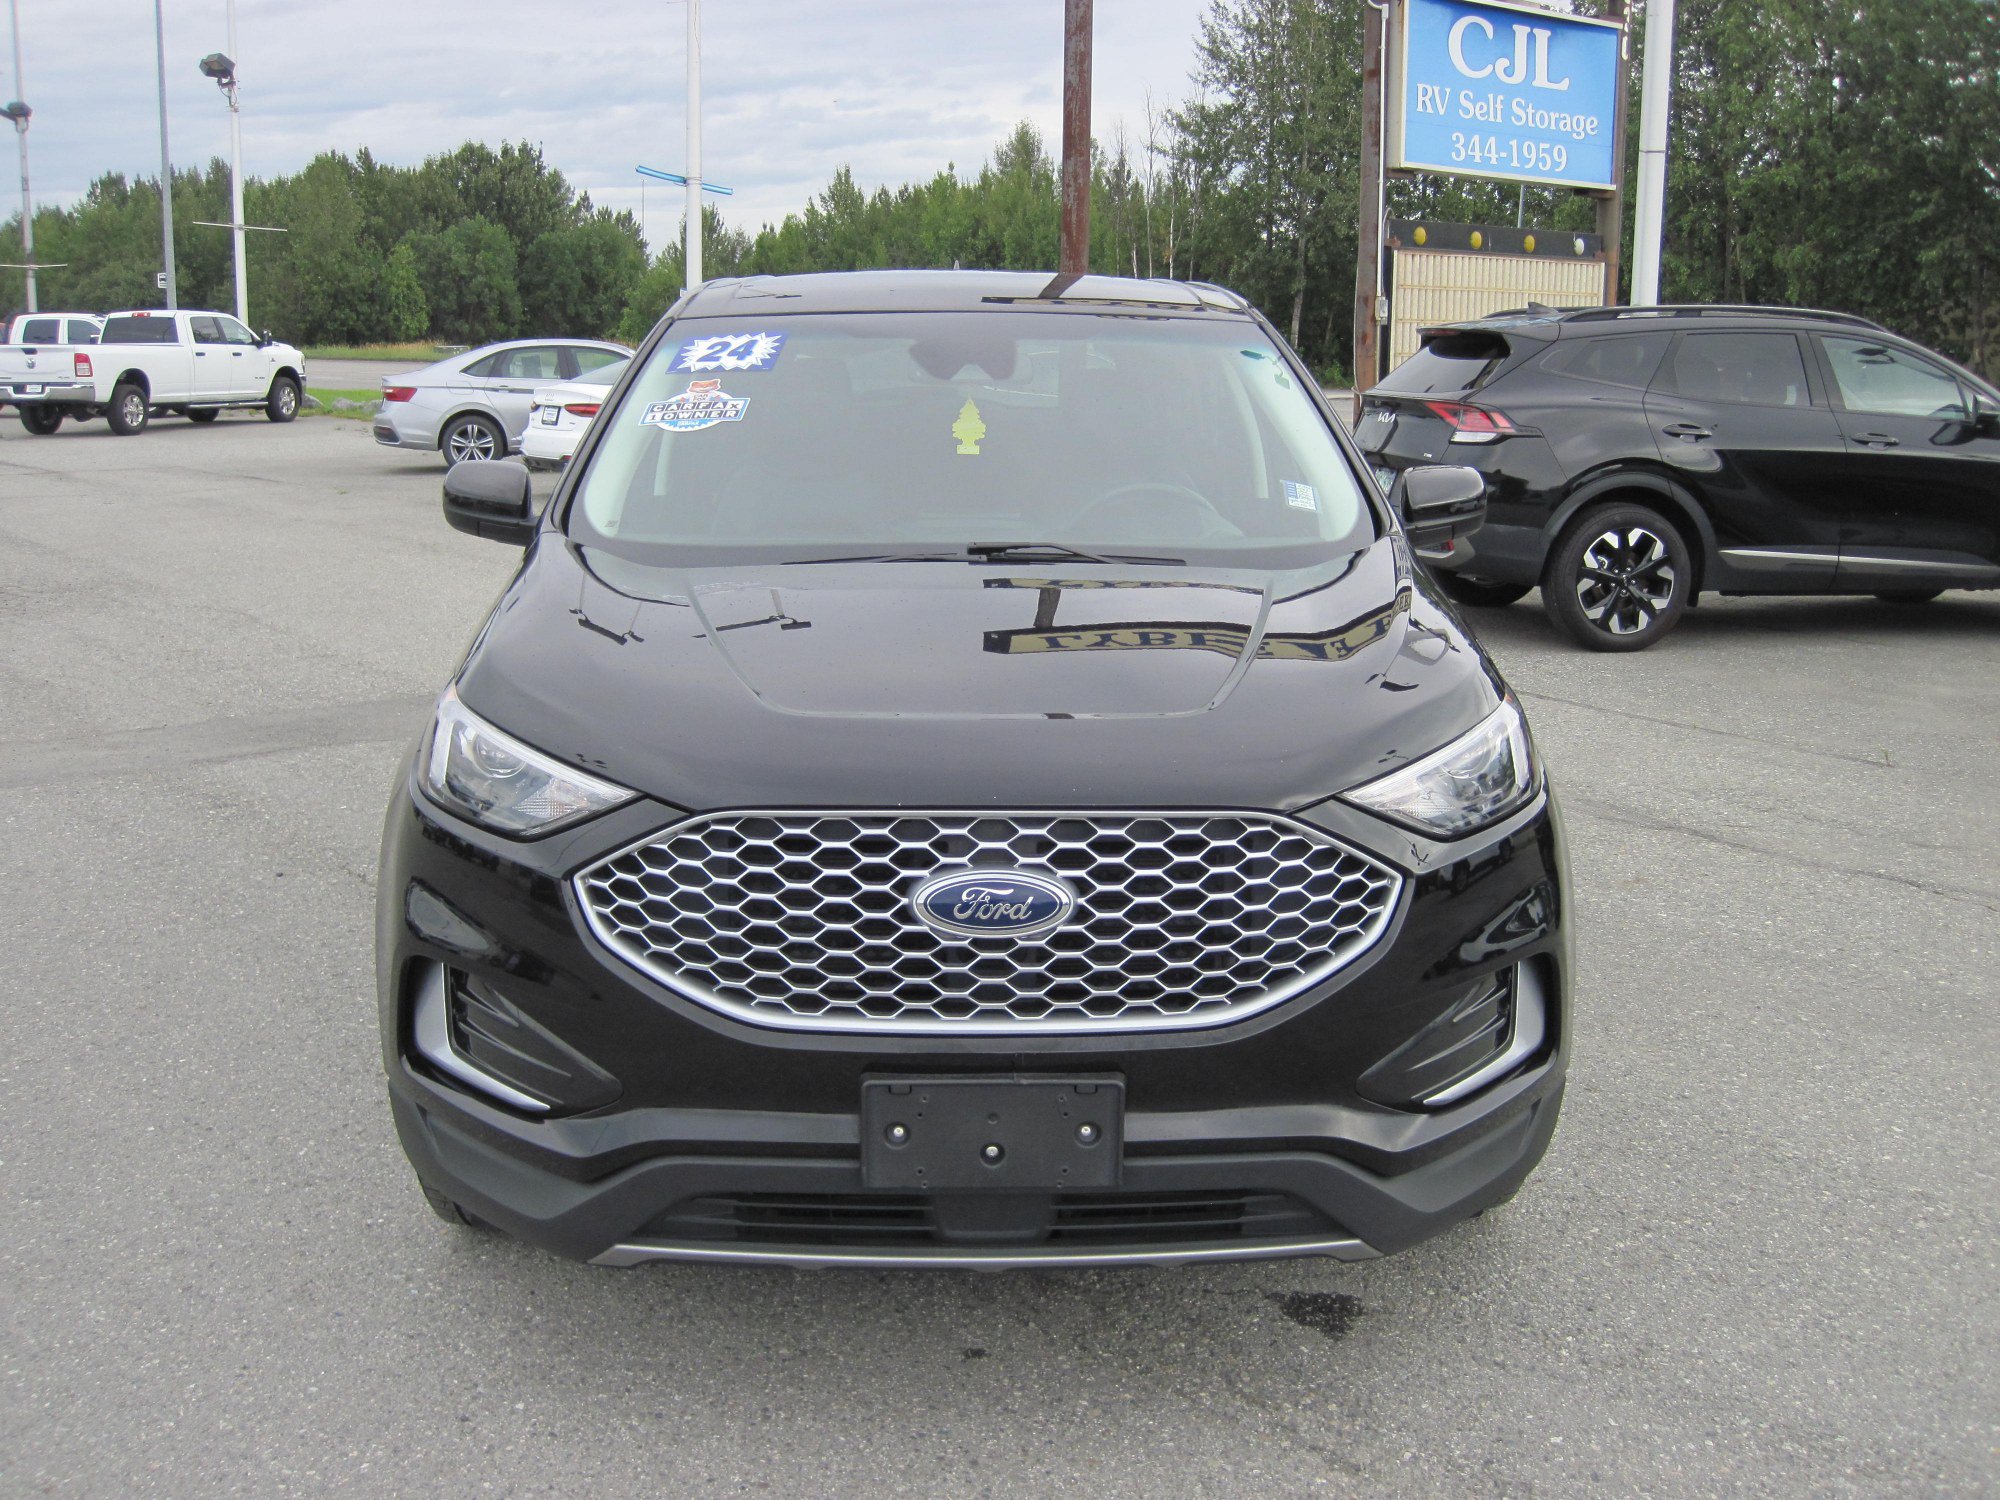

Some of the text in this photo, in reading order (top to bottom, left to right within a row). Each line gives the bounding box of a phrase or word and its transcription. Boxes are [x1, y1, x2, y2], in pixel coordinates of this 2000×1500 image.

[1447, 15, 1570, 91] CJL
[1416, 83, 1599, 140] RV Self Storage
[1451, 131, 1568, 172] 344-1959
[695, 339, 758, 362] 24
[653, 402, 740, 412] CARFAX
[663, 410, 737, 420] OWNER
[953, 887, 1035, 920] Ford
